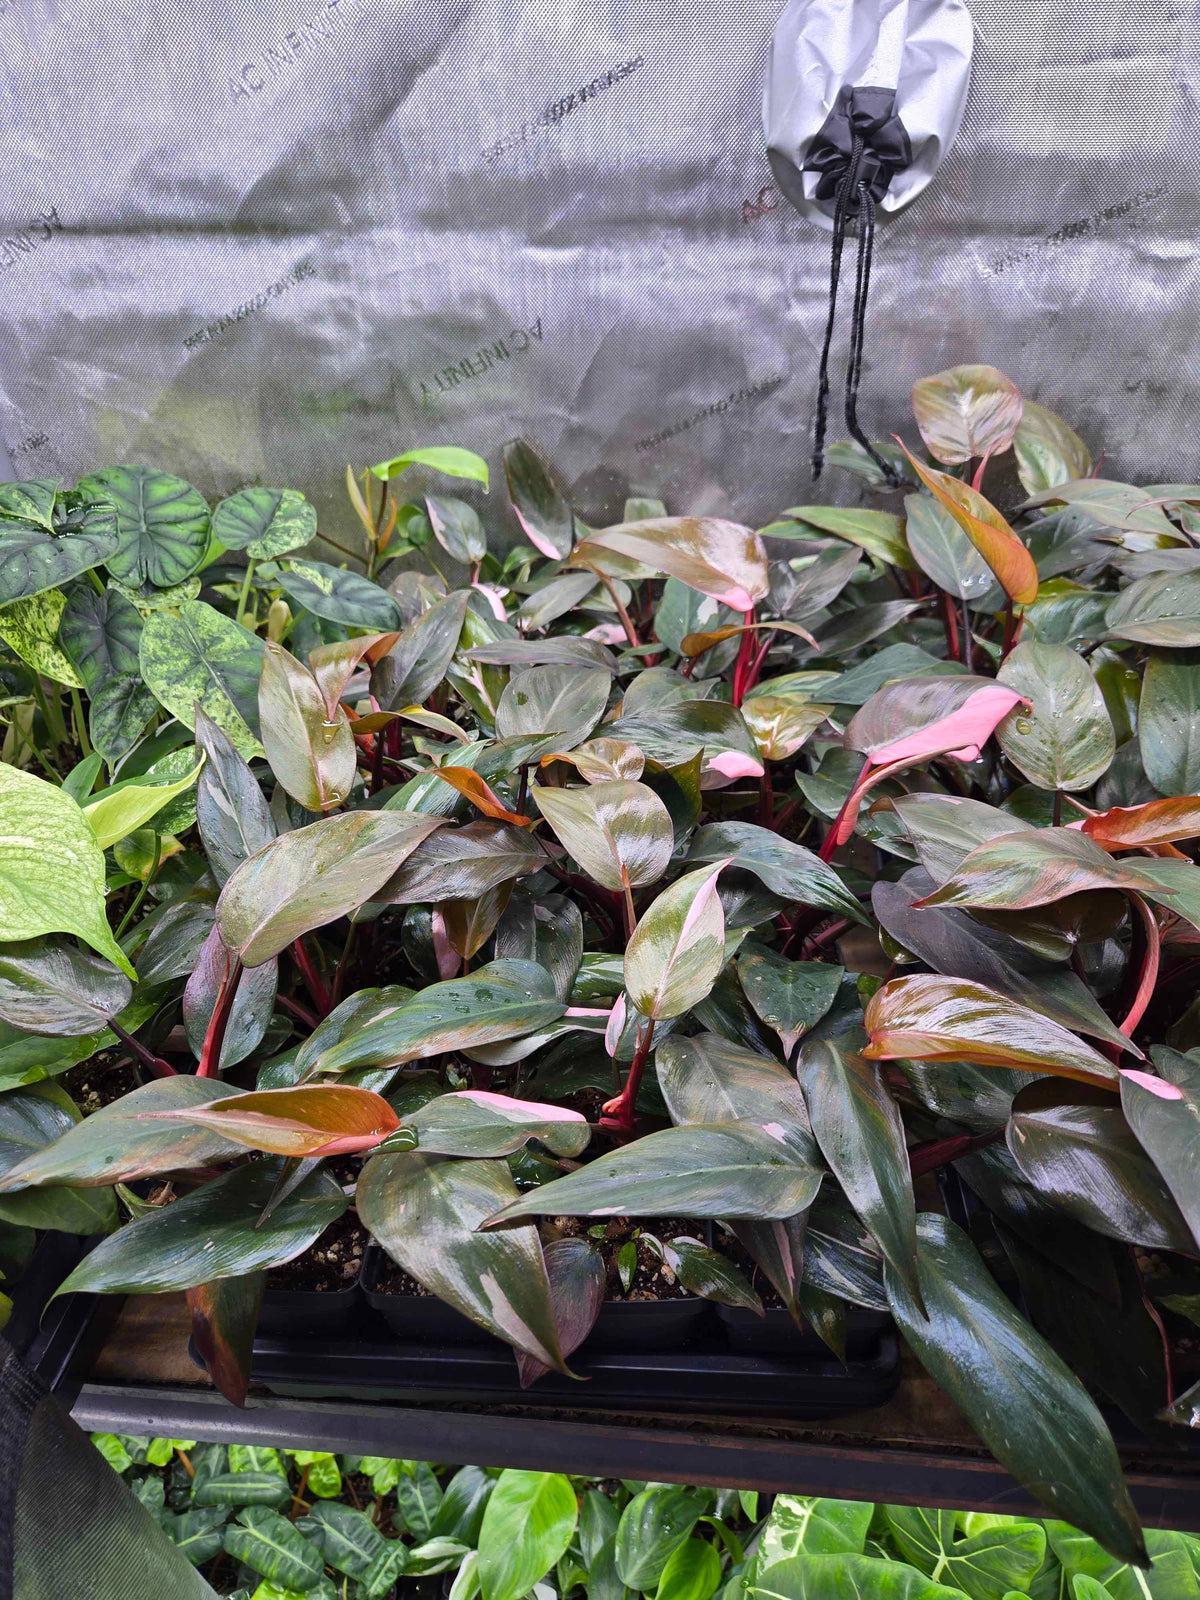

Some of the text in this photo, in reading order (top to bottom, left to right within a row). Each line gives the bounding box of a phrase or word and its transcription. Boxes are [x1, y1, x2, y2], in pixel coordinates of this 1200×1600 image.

[228, 63, 265, 104] AC
[29, 205, 63, 242] AC
[738, 186, 780, 224] AC
[419, 318, 543, 412] AC INFINITY
